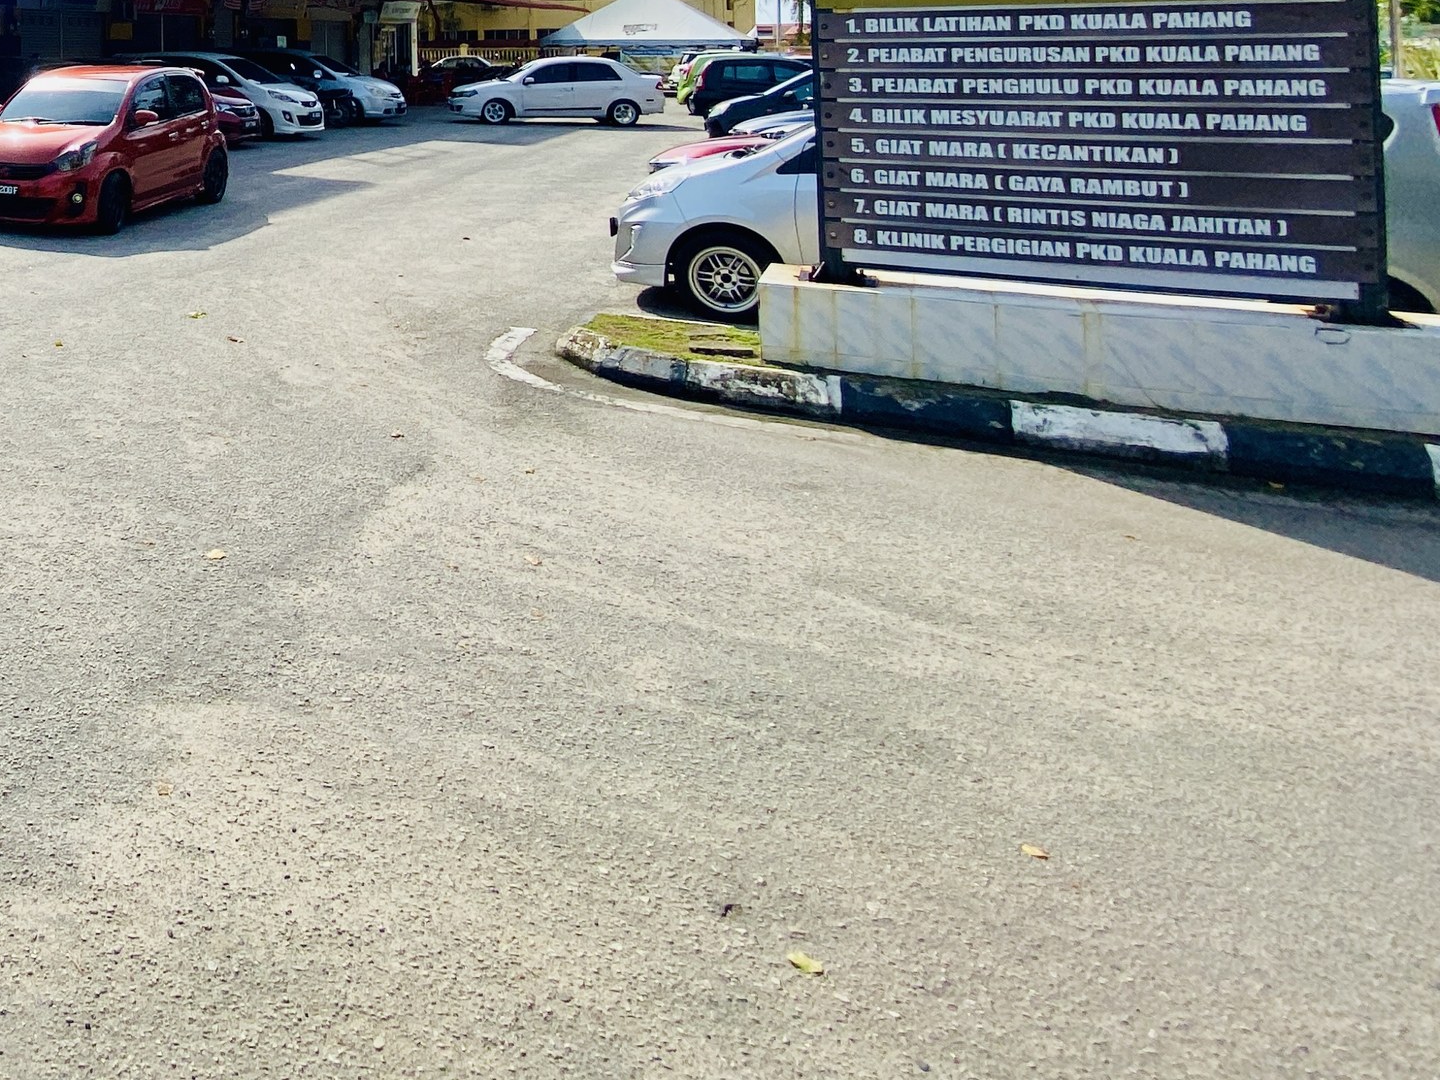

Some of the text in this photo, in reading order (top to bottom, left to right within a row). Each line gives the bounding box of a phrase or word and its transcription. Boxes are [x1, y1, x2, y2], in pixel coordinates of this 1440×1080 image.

[846, 11, 1251, 33] 1. BILIK LATIHAN PKD KUALA PAHANG
[847, 45, 1319, 62] 2. PEJABAT PENGURUSAN PKD KUALA PAHANG
[849, 78, 1326, 96] 3. PEJABAT PENGHULU PKD KUALA PAHANG
[849, 109, 1306, 131] 4. BILIK MESYUARAT PKD KUALA PAHANG
[852, 138, 870, 153] 5.
[876, 139, 923, 155] GIAT
[929, 141, 993, 157] MARA
[1013, 144, 1163, 163] KECANTIKAN
[851, 169, 869, 183] 6.
[875, 170, 920, 185] GIAT
[926, 172, 989, 189] MARA
[1009, 176, 1065, 192] GAYA
[1071, 178, 1173, 197] RAMBUT
[854, 199, 870, 213] 7.
[875, 200, 921, 216] GIAT
[926, 203, 989, 221] MARA
[1008, 208, 1086, 226] RINTIS
[1092, 212, 1165, 231] NIAGA
[1171, 216, 1271, 235] JAHITAN
[854, 229, 1316, 273] 8. KLINIK PERGIGIAN PKD KUALA PAHANG
